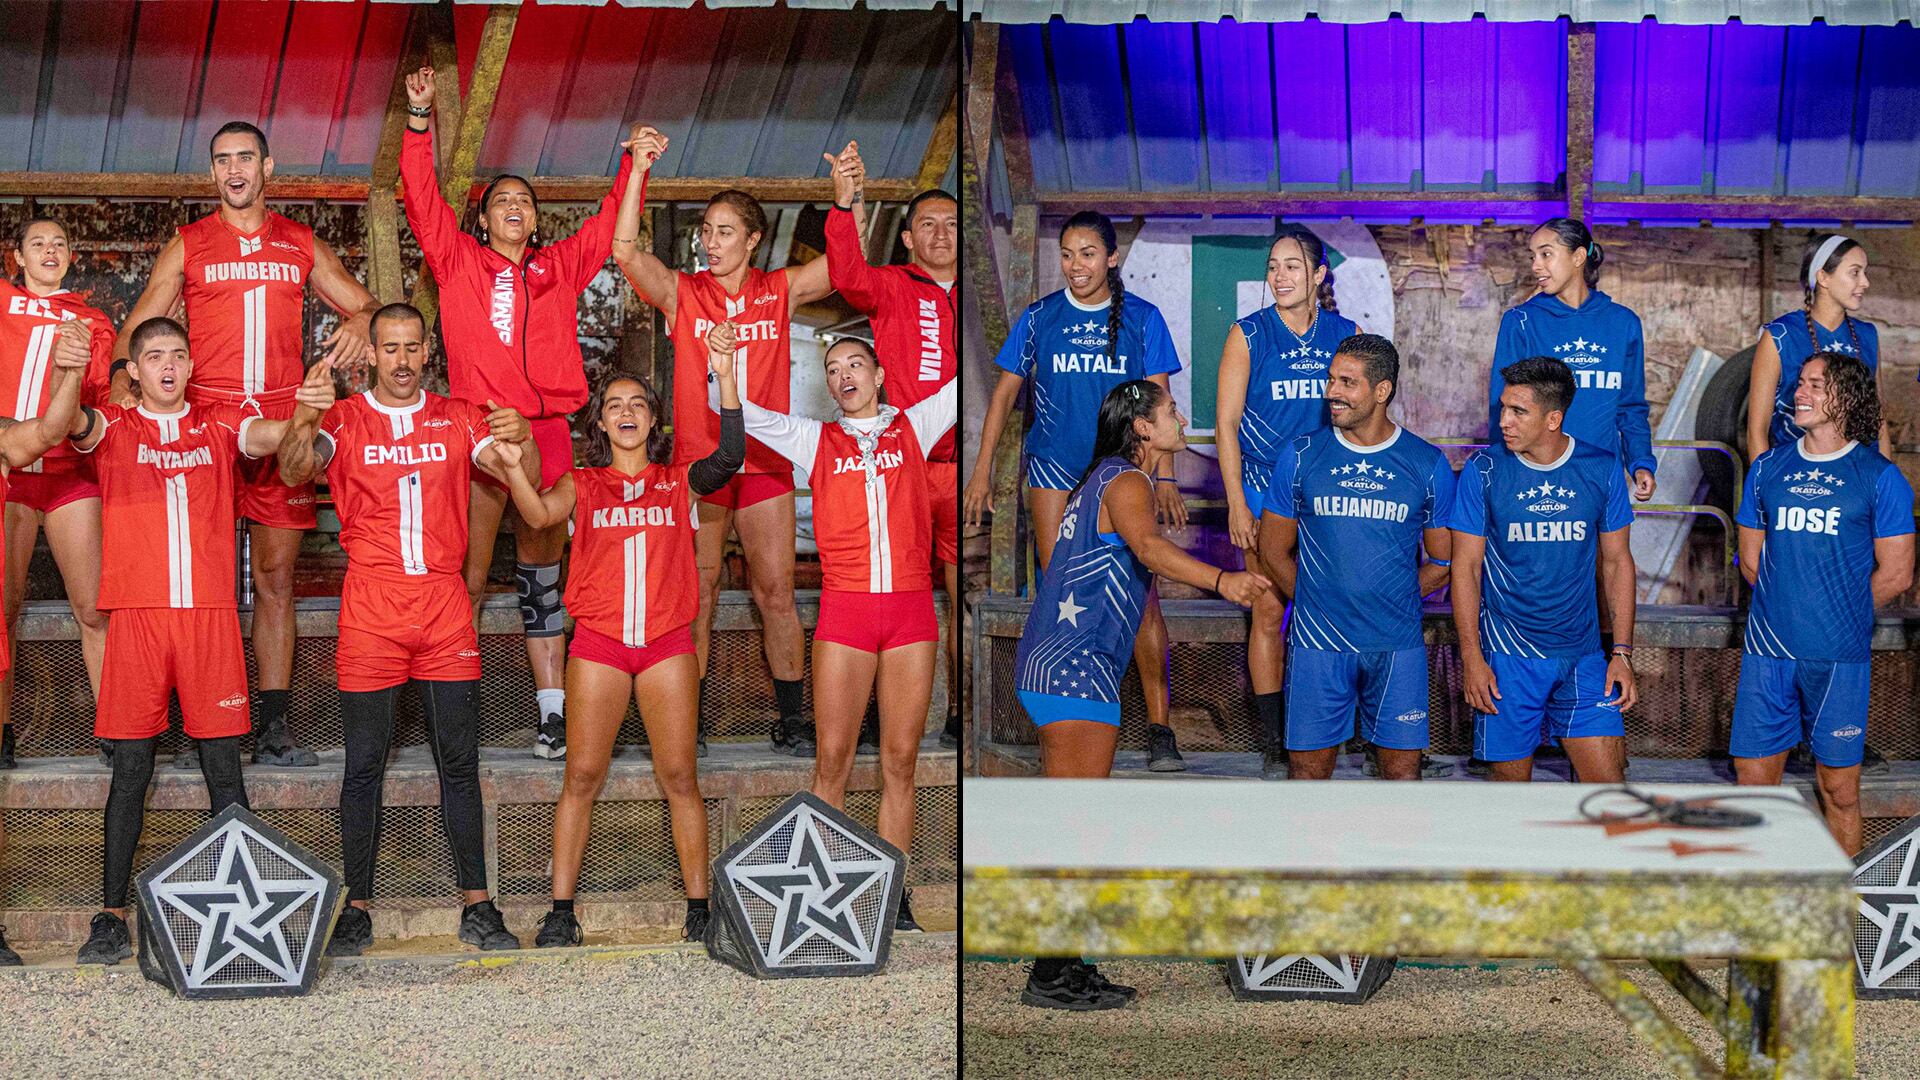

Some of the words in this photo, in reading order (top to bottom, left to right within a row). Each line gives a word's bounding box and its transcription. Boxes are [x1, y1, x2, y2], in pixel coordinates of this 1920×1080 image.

[204, 261, 300, 285] HUMBERTO
[694, 318, 779, 341] PALETTE
[918, 298, 942, 381] VILLALUZ
[1053, 353, 1128, 374] NATALI
[1271, 379, 1329, 401] EVELY
[364, 442, 447, 465] EMILIO
[592, 506, 676, 529] KAROL
[1313, 496, 1409, 523] ALEJANDRO
[1775, 506, 1841, 536] JOSÉ
[1507, 521, 1587, 542] ALEXIS
